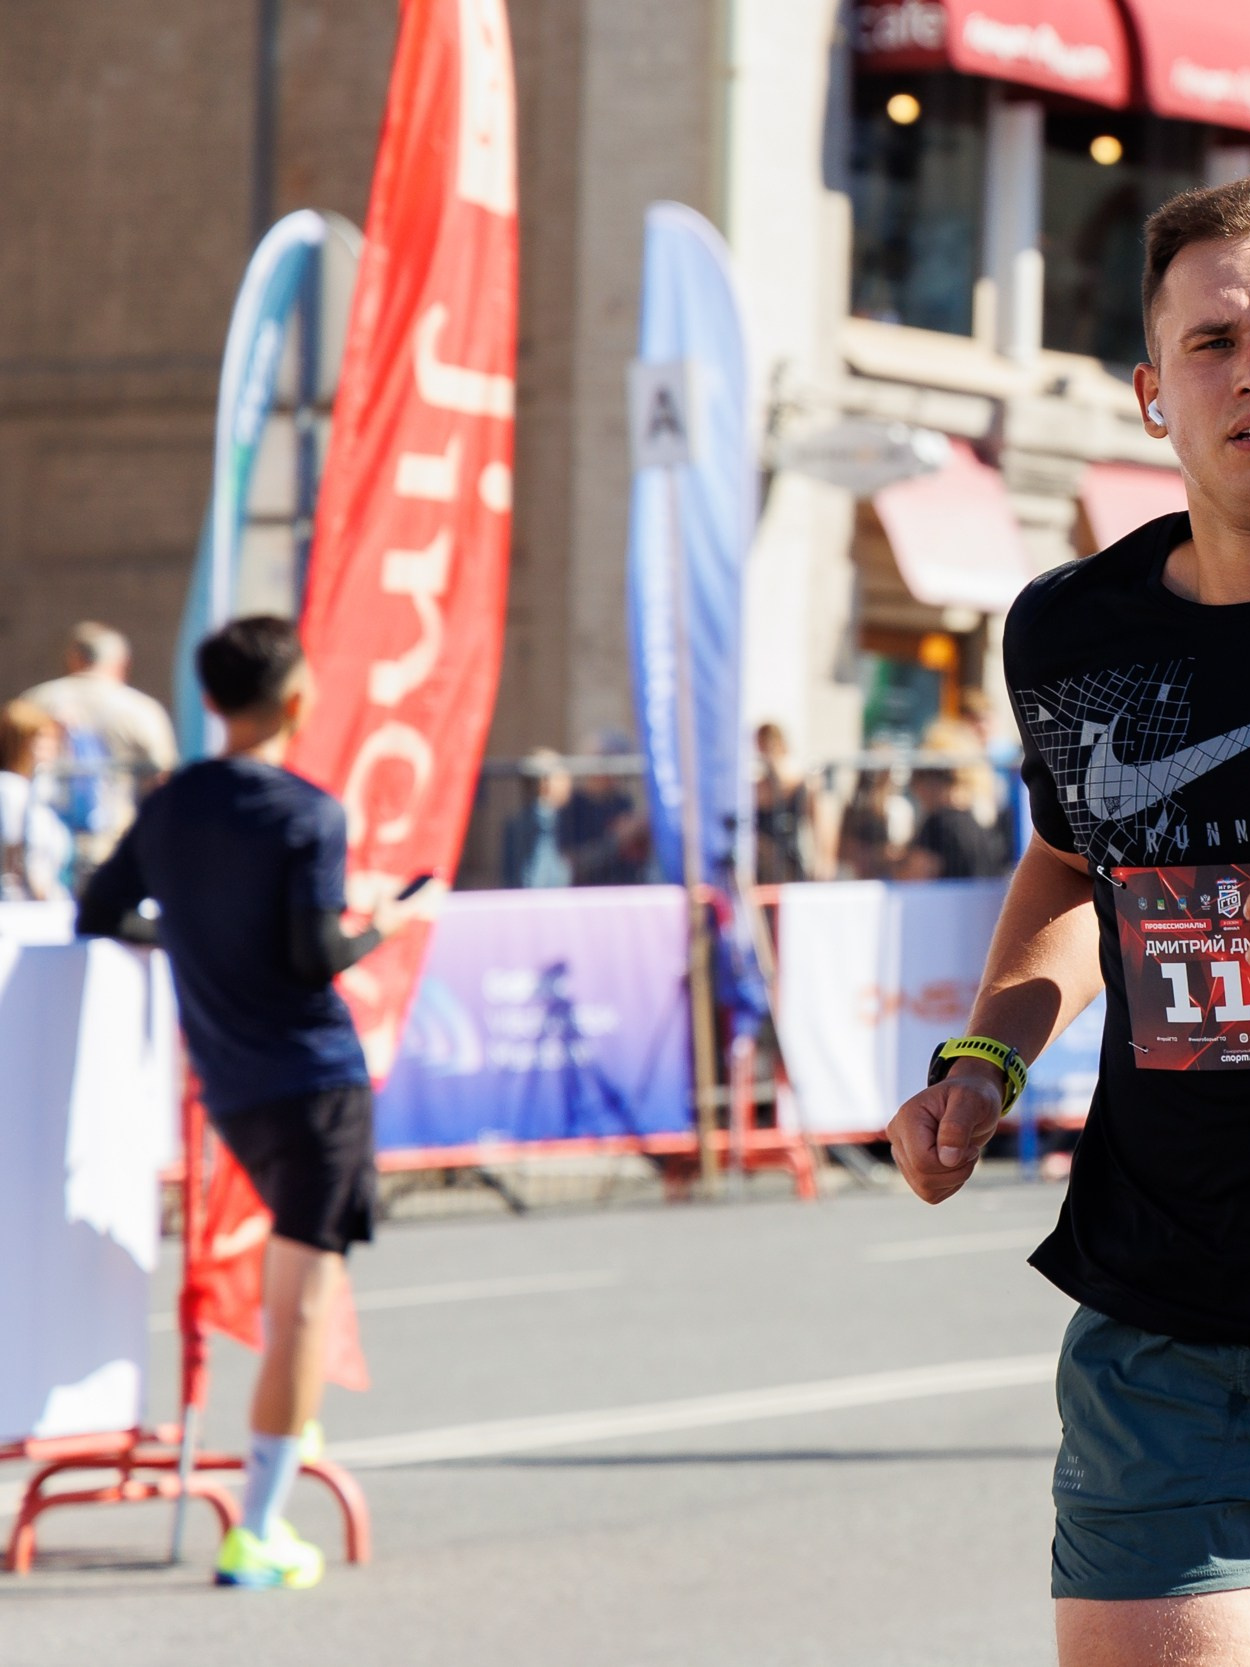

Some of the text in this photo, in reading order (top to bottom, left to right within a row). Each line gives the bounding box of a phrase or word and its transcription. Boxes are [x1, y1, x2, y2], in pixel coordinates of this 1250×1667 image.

[1220, 895, 1238, 908] ГТО
[1144, 921, 1207, 931] ПРОФЕССИОНАЛЫ
[1145, 934, 1226, 956] ДМИТРИЙ
